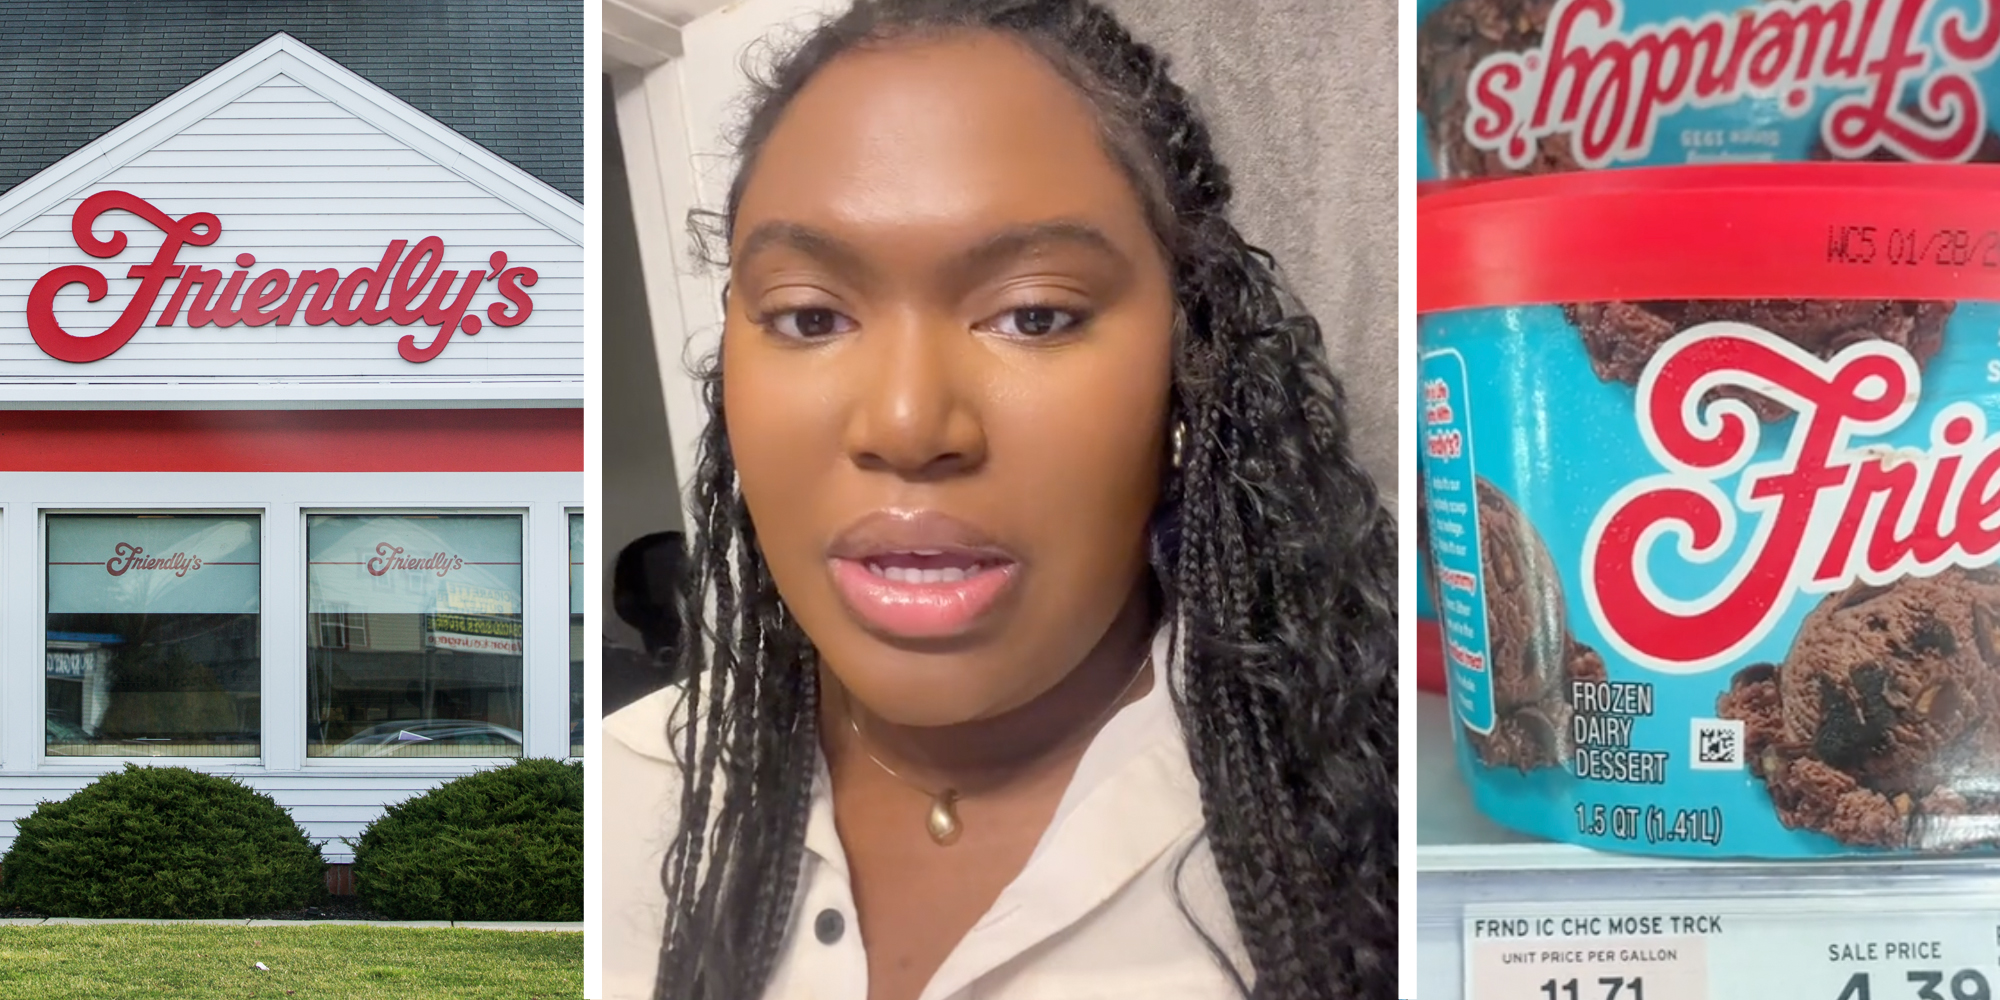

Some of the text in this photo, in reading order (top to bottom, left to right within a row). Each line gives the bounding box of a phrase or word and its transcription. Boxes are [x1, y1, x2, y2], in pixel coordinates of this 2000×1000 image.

[1471, 0, 2000, 162] Friendly's
[1827, 225, 1878, 264] WC5
[26, 190, 539, 364] Friendly's
[106, 541, 202, 577] Friendly's
[366, 541, 463, 577] Friendly's
[1572, 681, 1653, 715] FROZEN
[1574, 715, 1633, 747] DAIRY
[1576, 748, 1668, 783] DESSERT
[1575, 803, 1722, 844] 1.5 QT (1.41L)
[1475, 916, 1723, 937] FRND IC CHC MOSE TRCK
[1502, 949, 1677, 964] UNIT PRICE PER GALLON
[1828, 941, 1942, 961] SALE PRICE
[1540, 976, 1644, 1000] 1171
[1836, 968, 1991, 1000] 439
